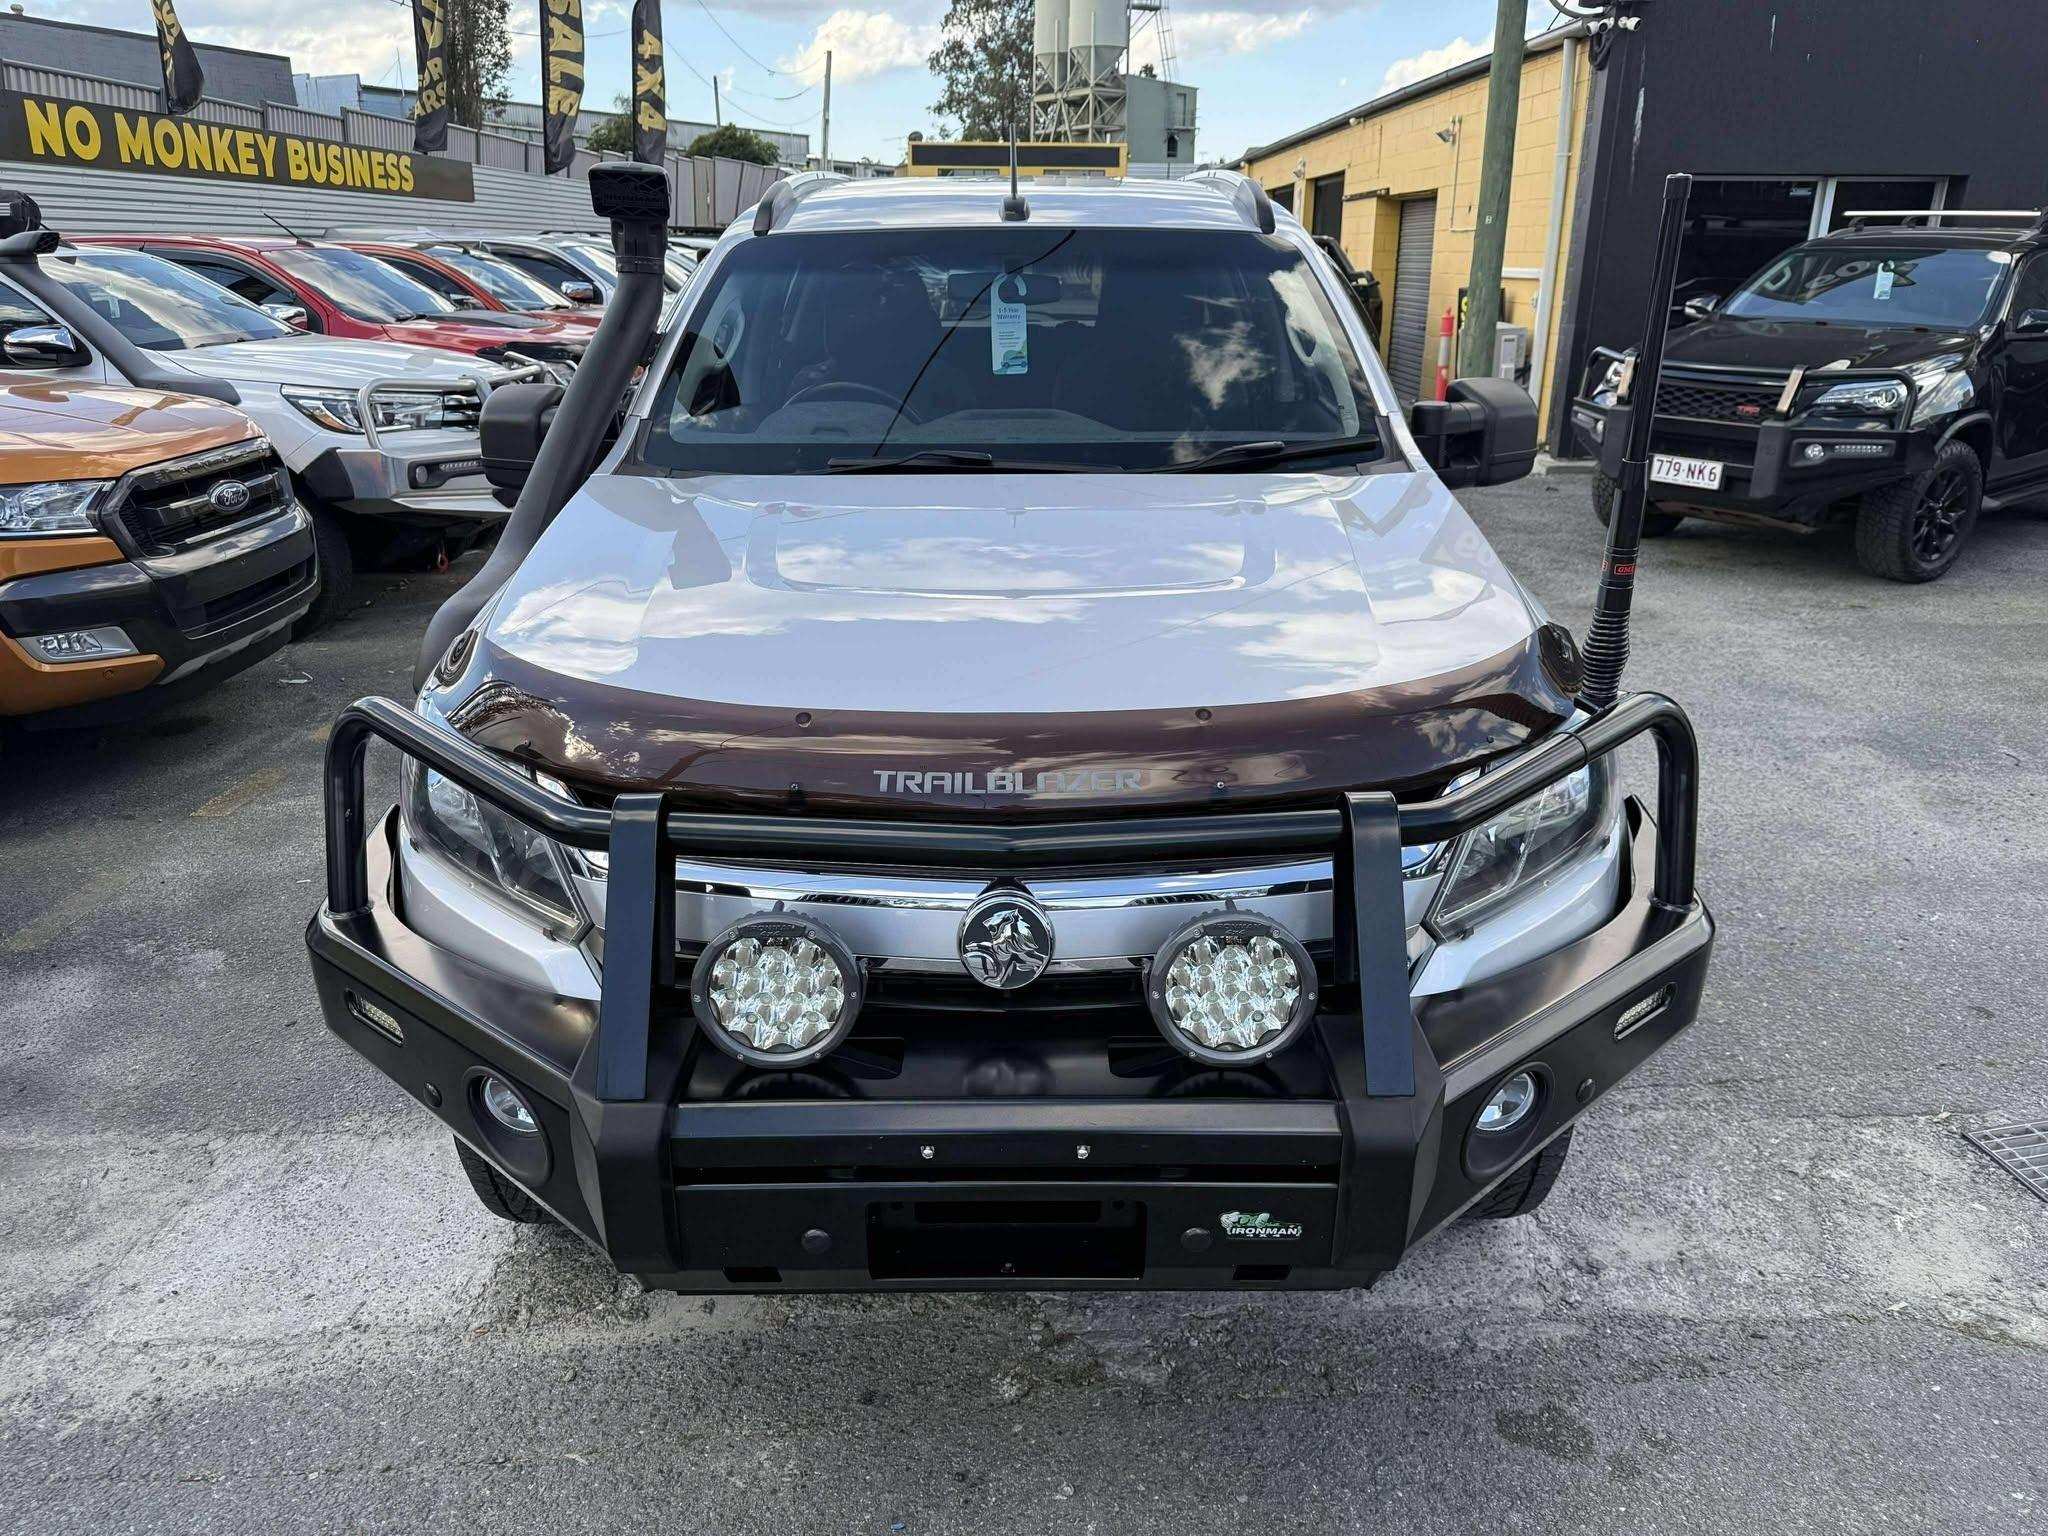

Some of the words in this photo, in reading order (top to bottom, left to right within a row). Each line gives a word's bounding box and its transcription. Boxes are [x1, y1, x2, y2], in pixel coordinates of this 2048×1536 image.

[23, 99, 101, 161] NO
[114, 112, 277, 178] MONKEY
[286, 138, 415, 192] BUSINESS
[221, 487, 246, 505] Ford
[873, 769, 1142, 794] TRAILBLAZER
[1231, 1227, 1298, 1235] IRONMAN
